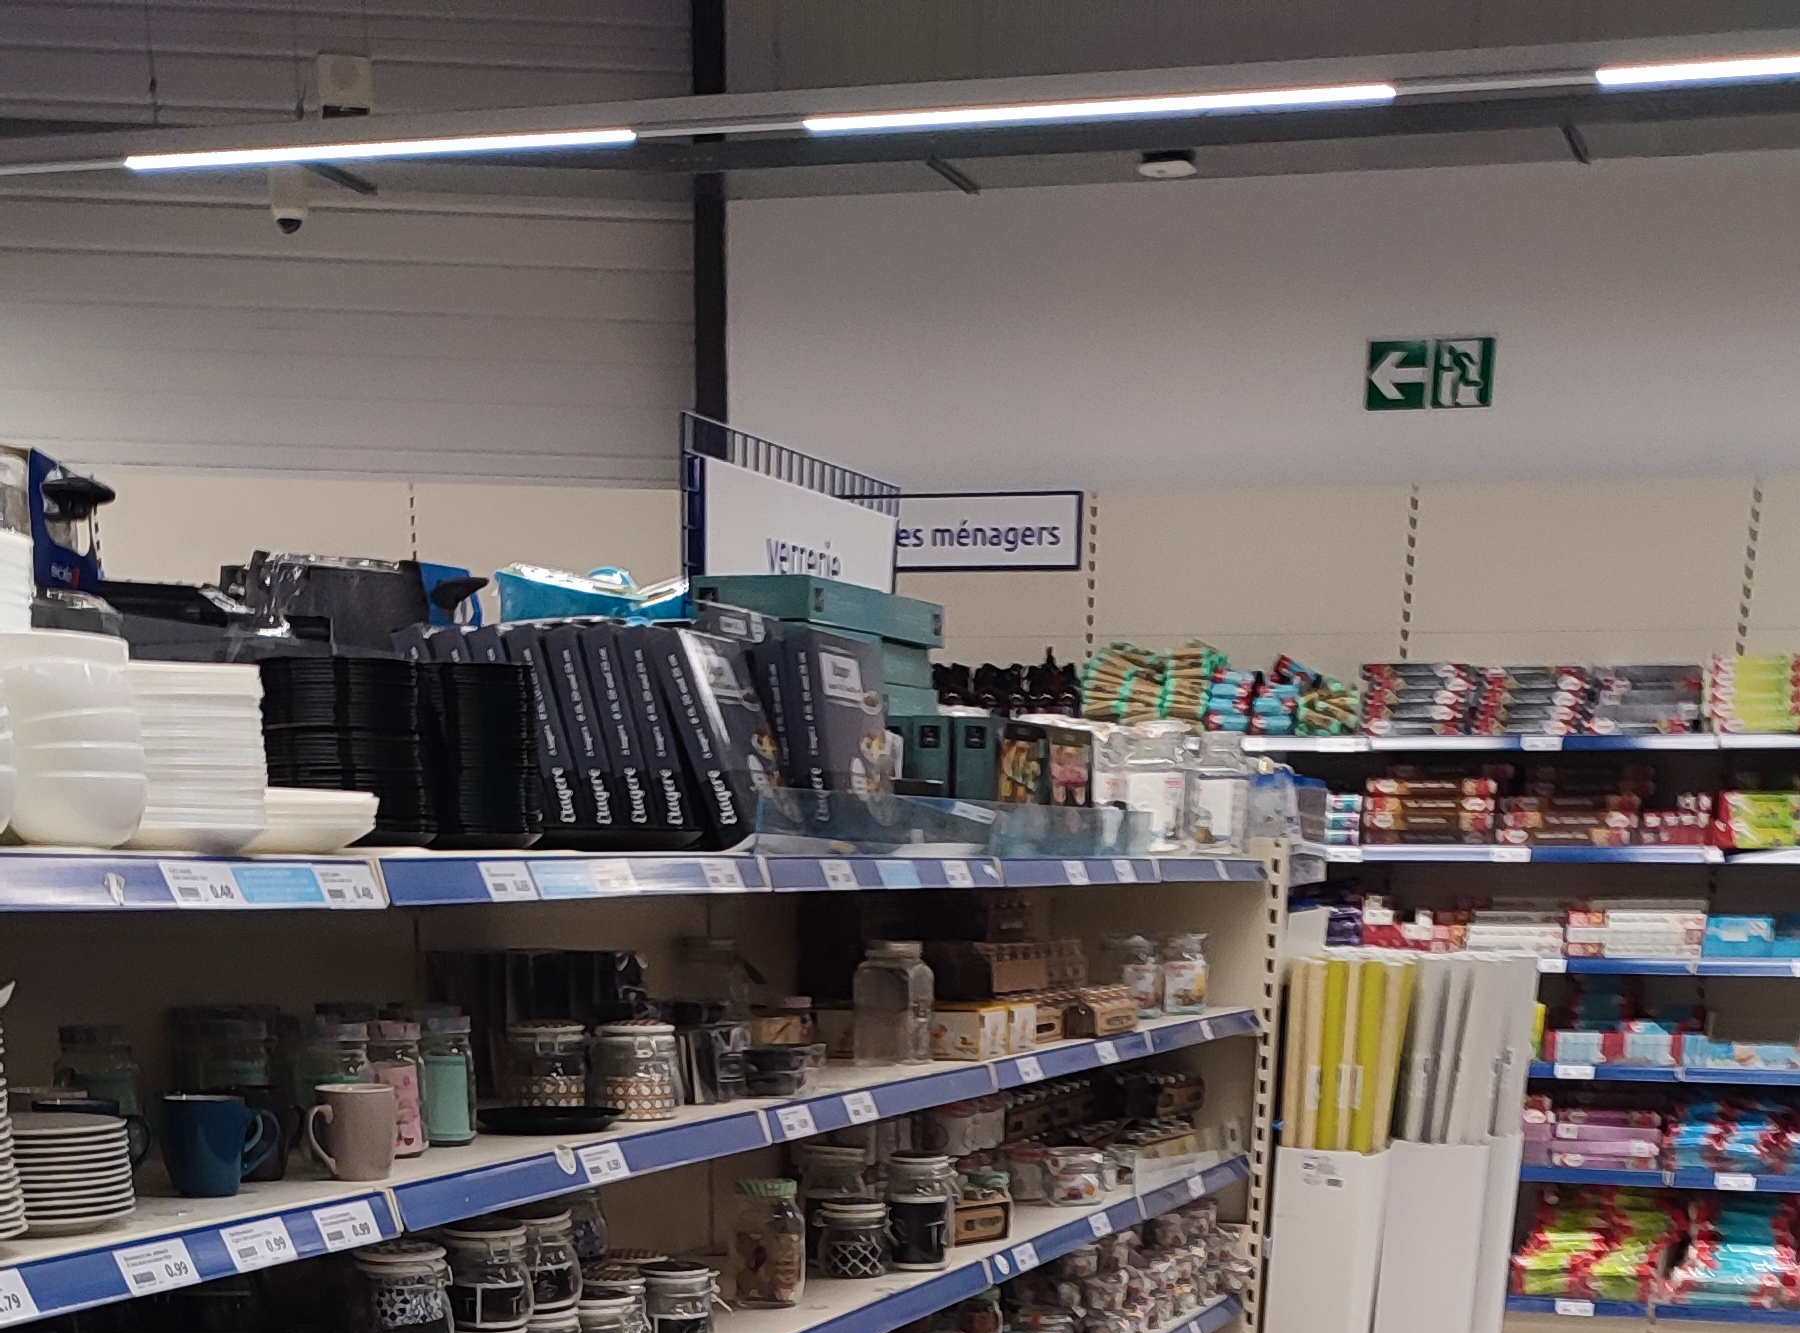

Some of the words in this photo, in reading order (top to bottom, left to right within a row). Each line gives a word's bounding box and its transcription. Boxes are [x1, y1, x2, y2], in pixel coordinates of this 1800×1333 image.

[931, 519, 1061, 553] ménagers
[352, 1221, 372, 1238] 0.99
[265, 1235, 287, 1253] 0.99
[164, 1260, 190, 1279] 0.99
